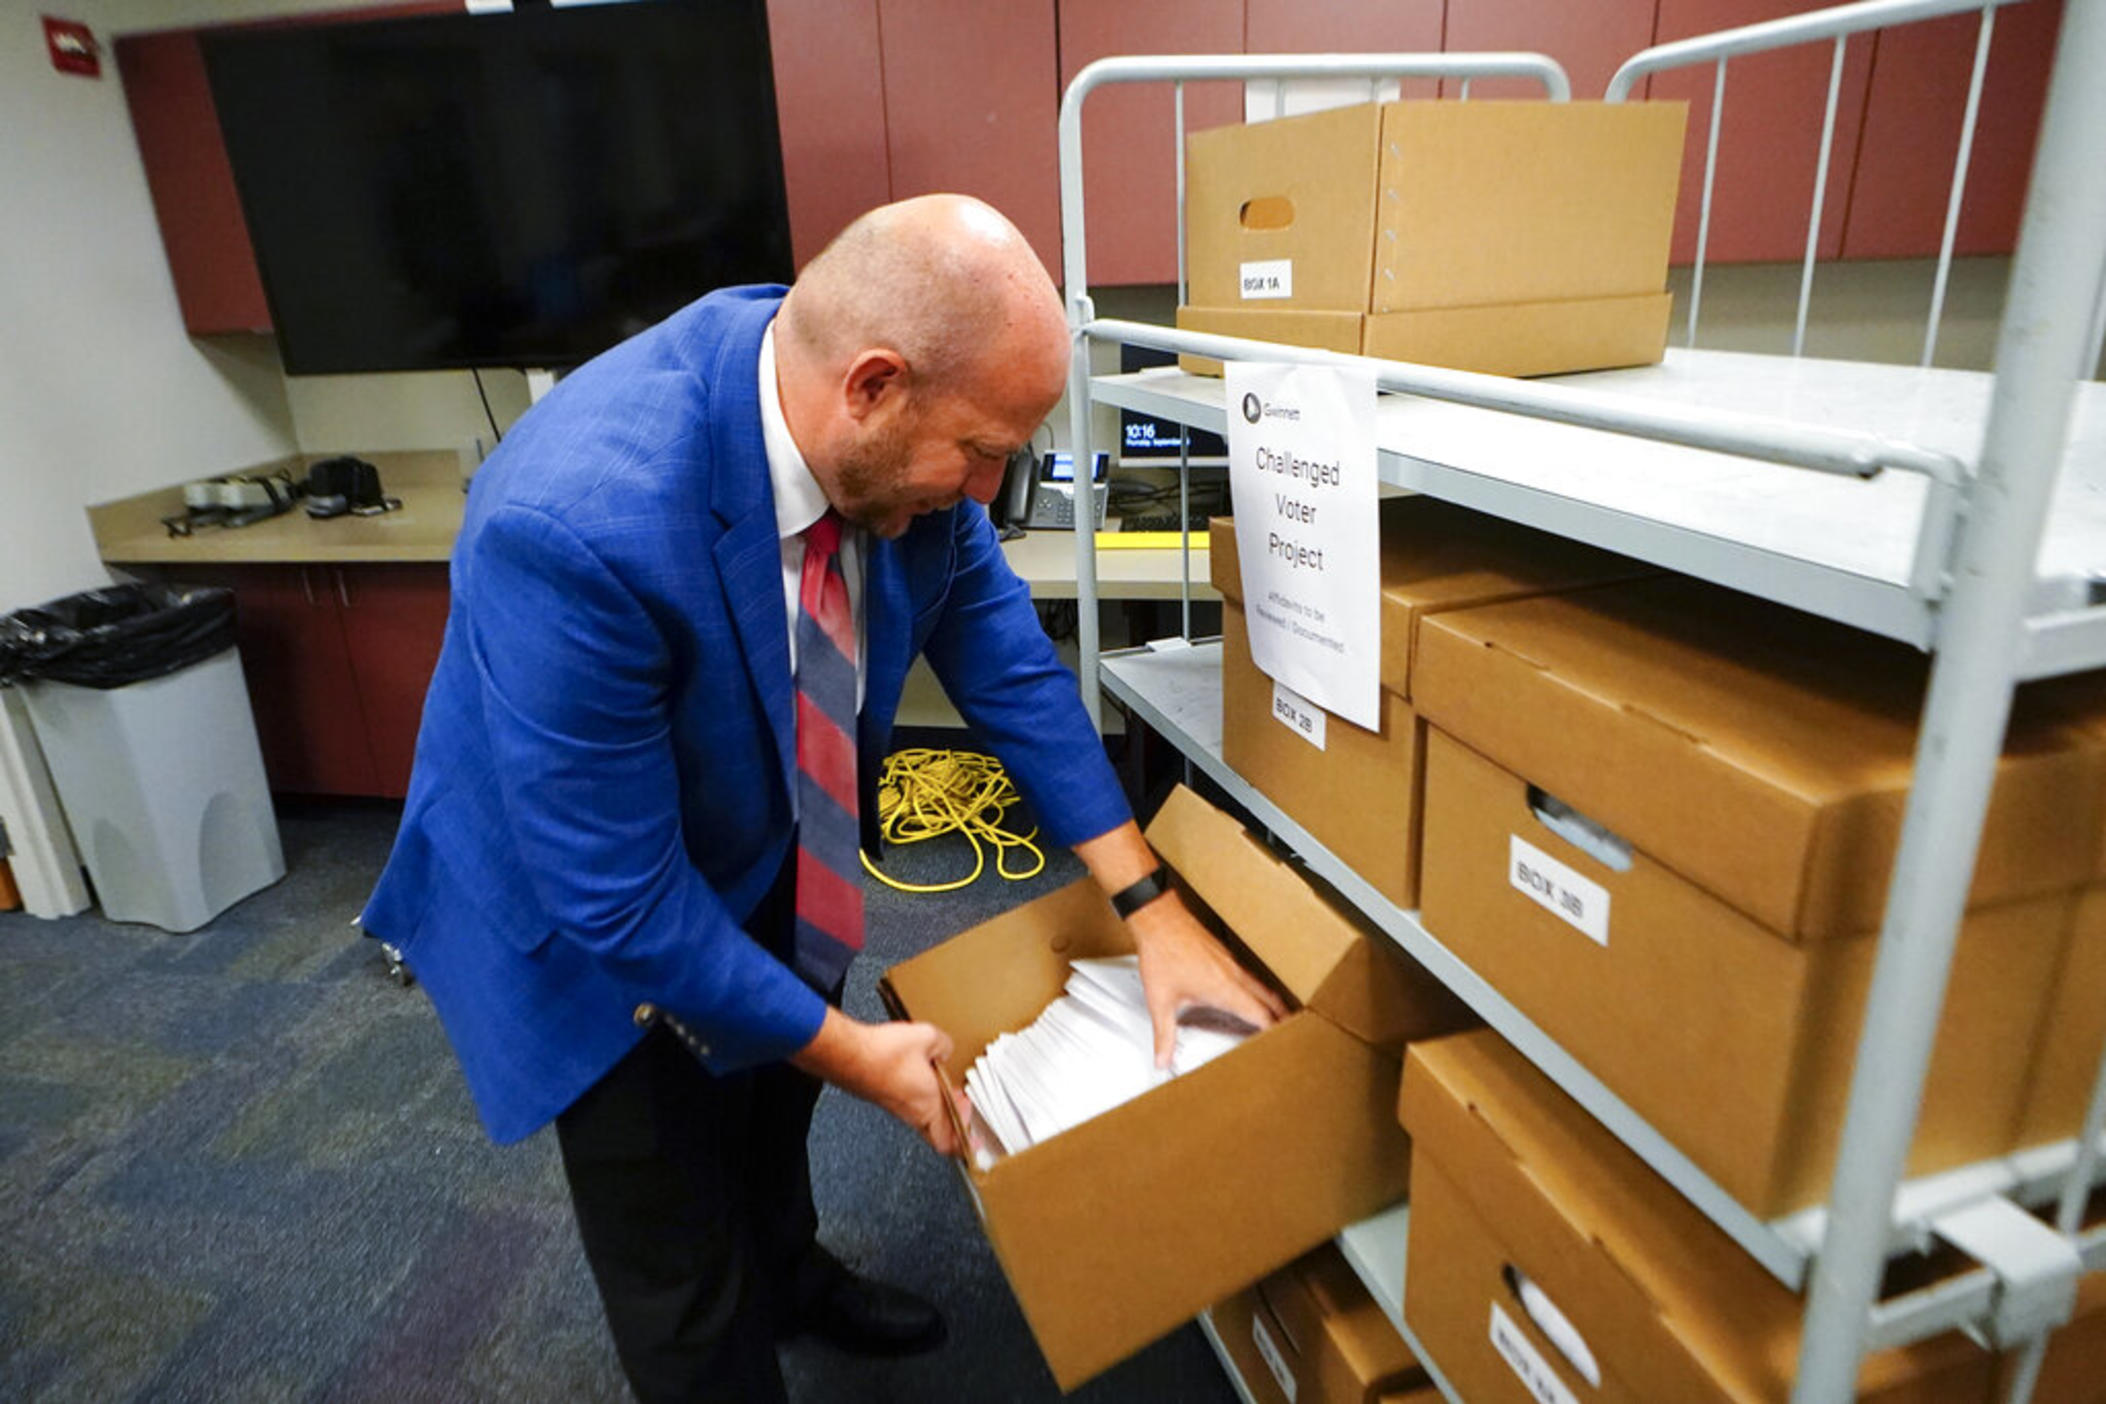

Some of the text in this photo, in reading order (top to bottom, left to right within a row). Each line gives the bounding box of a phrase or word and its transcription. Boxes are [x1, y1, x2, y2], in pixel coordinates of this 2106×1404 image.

[1125, 423, 1155, 439] 10:16
[1255, 446, 1340, 488] Challenged
[1276, 493, 1317, 525] Voter
[1268, 532, 1324, 571] Project
[1276, 696, 1313, 733] BOX 2B
[1517, 860, 1555, 900] BOX
